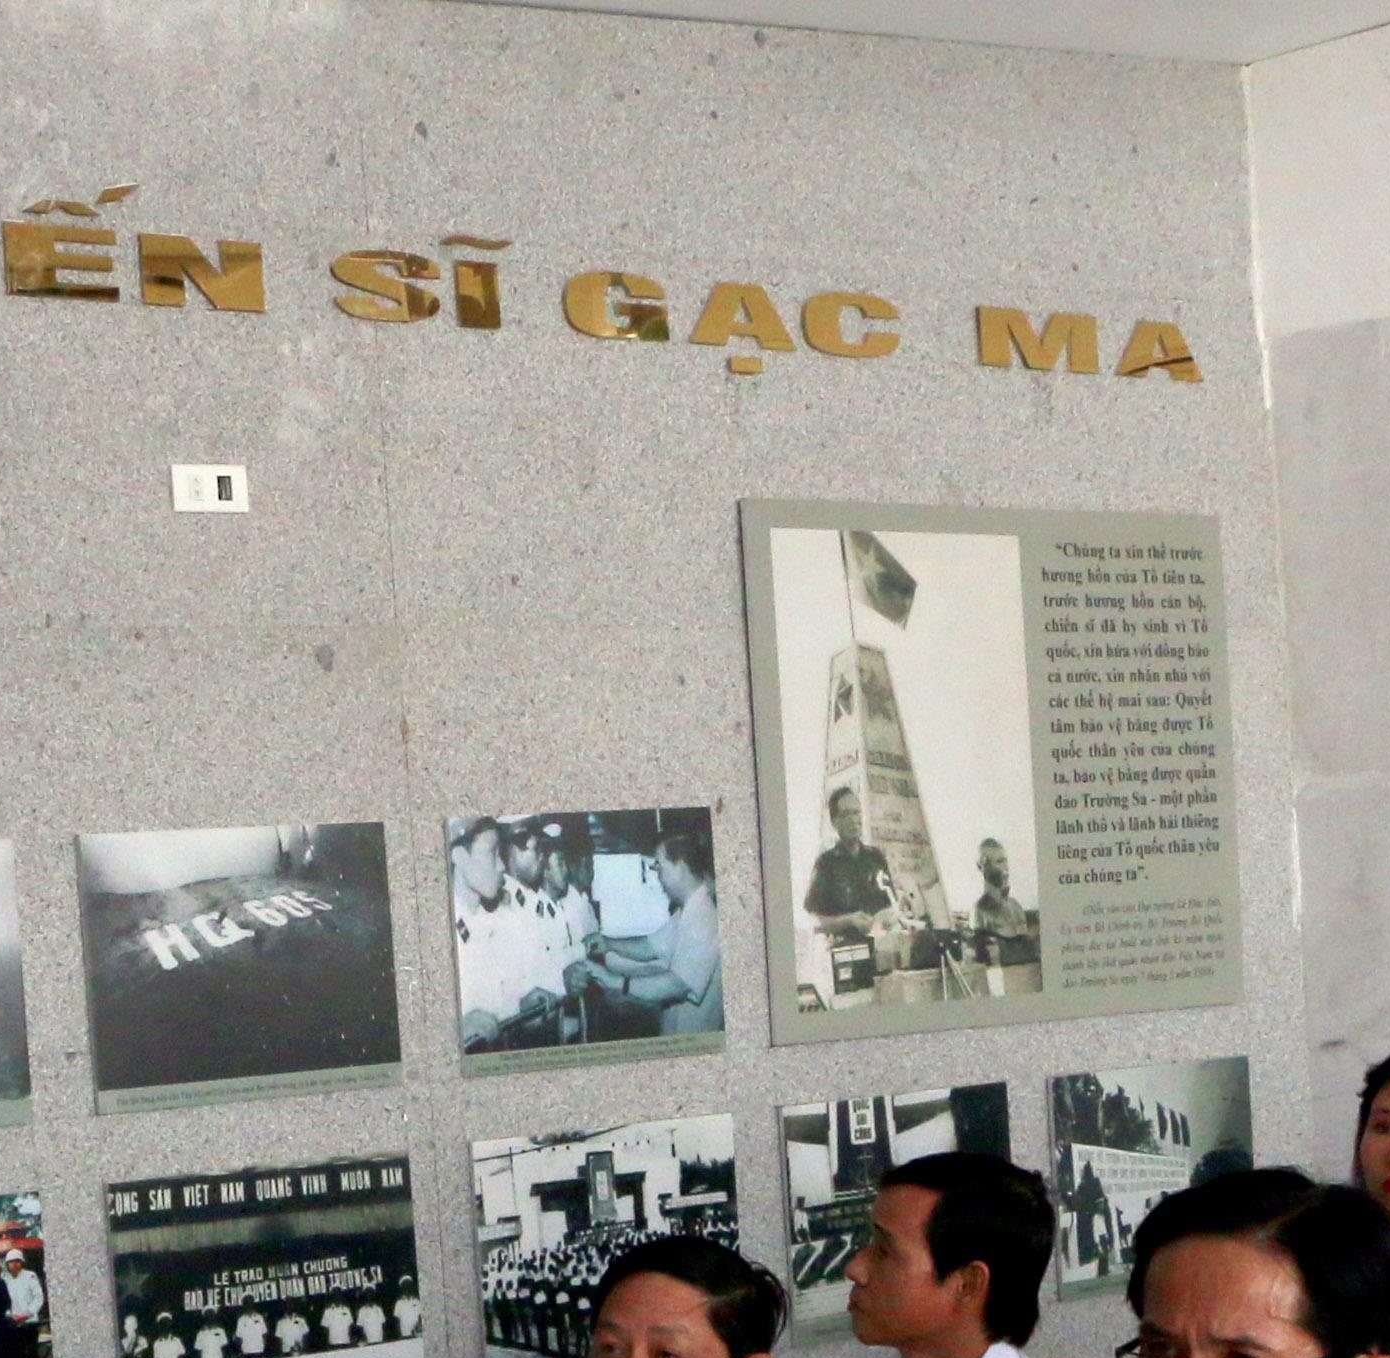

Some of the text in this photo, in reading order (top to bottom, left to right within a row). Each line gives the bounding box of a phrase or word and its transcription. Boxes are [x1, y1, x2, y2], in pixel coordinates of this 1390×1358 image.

[330, 236, 512, 329] SĨ
[564, 270, 901, 375] GẠC
[974, 305, 1204, 382] MA
[1110, 546, 1121, 559] ta
[1125, 544, 1144, 559] xin
[1044, 593, 1078, 608] trước
[1084, 643, 1103, 657] xin
[1106, 668, 1124, 683] xin
[1118, 693, 1142, 707] mai
[1132, 791, 1147, 806] Sa
[144, 910, 255, 971] HQ
[220, 1181, 244, 1203] NAM
[256, 1176, 292, 1201] QUANG
